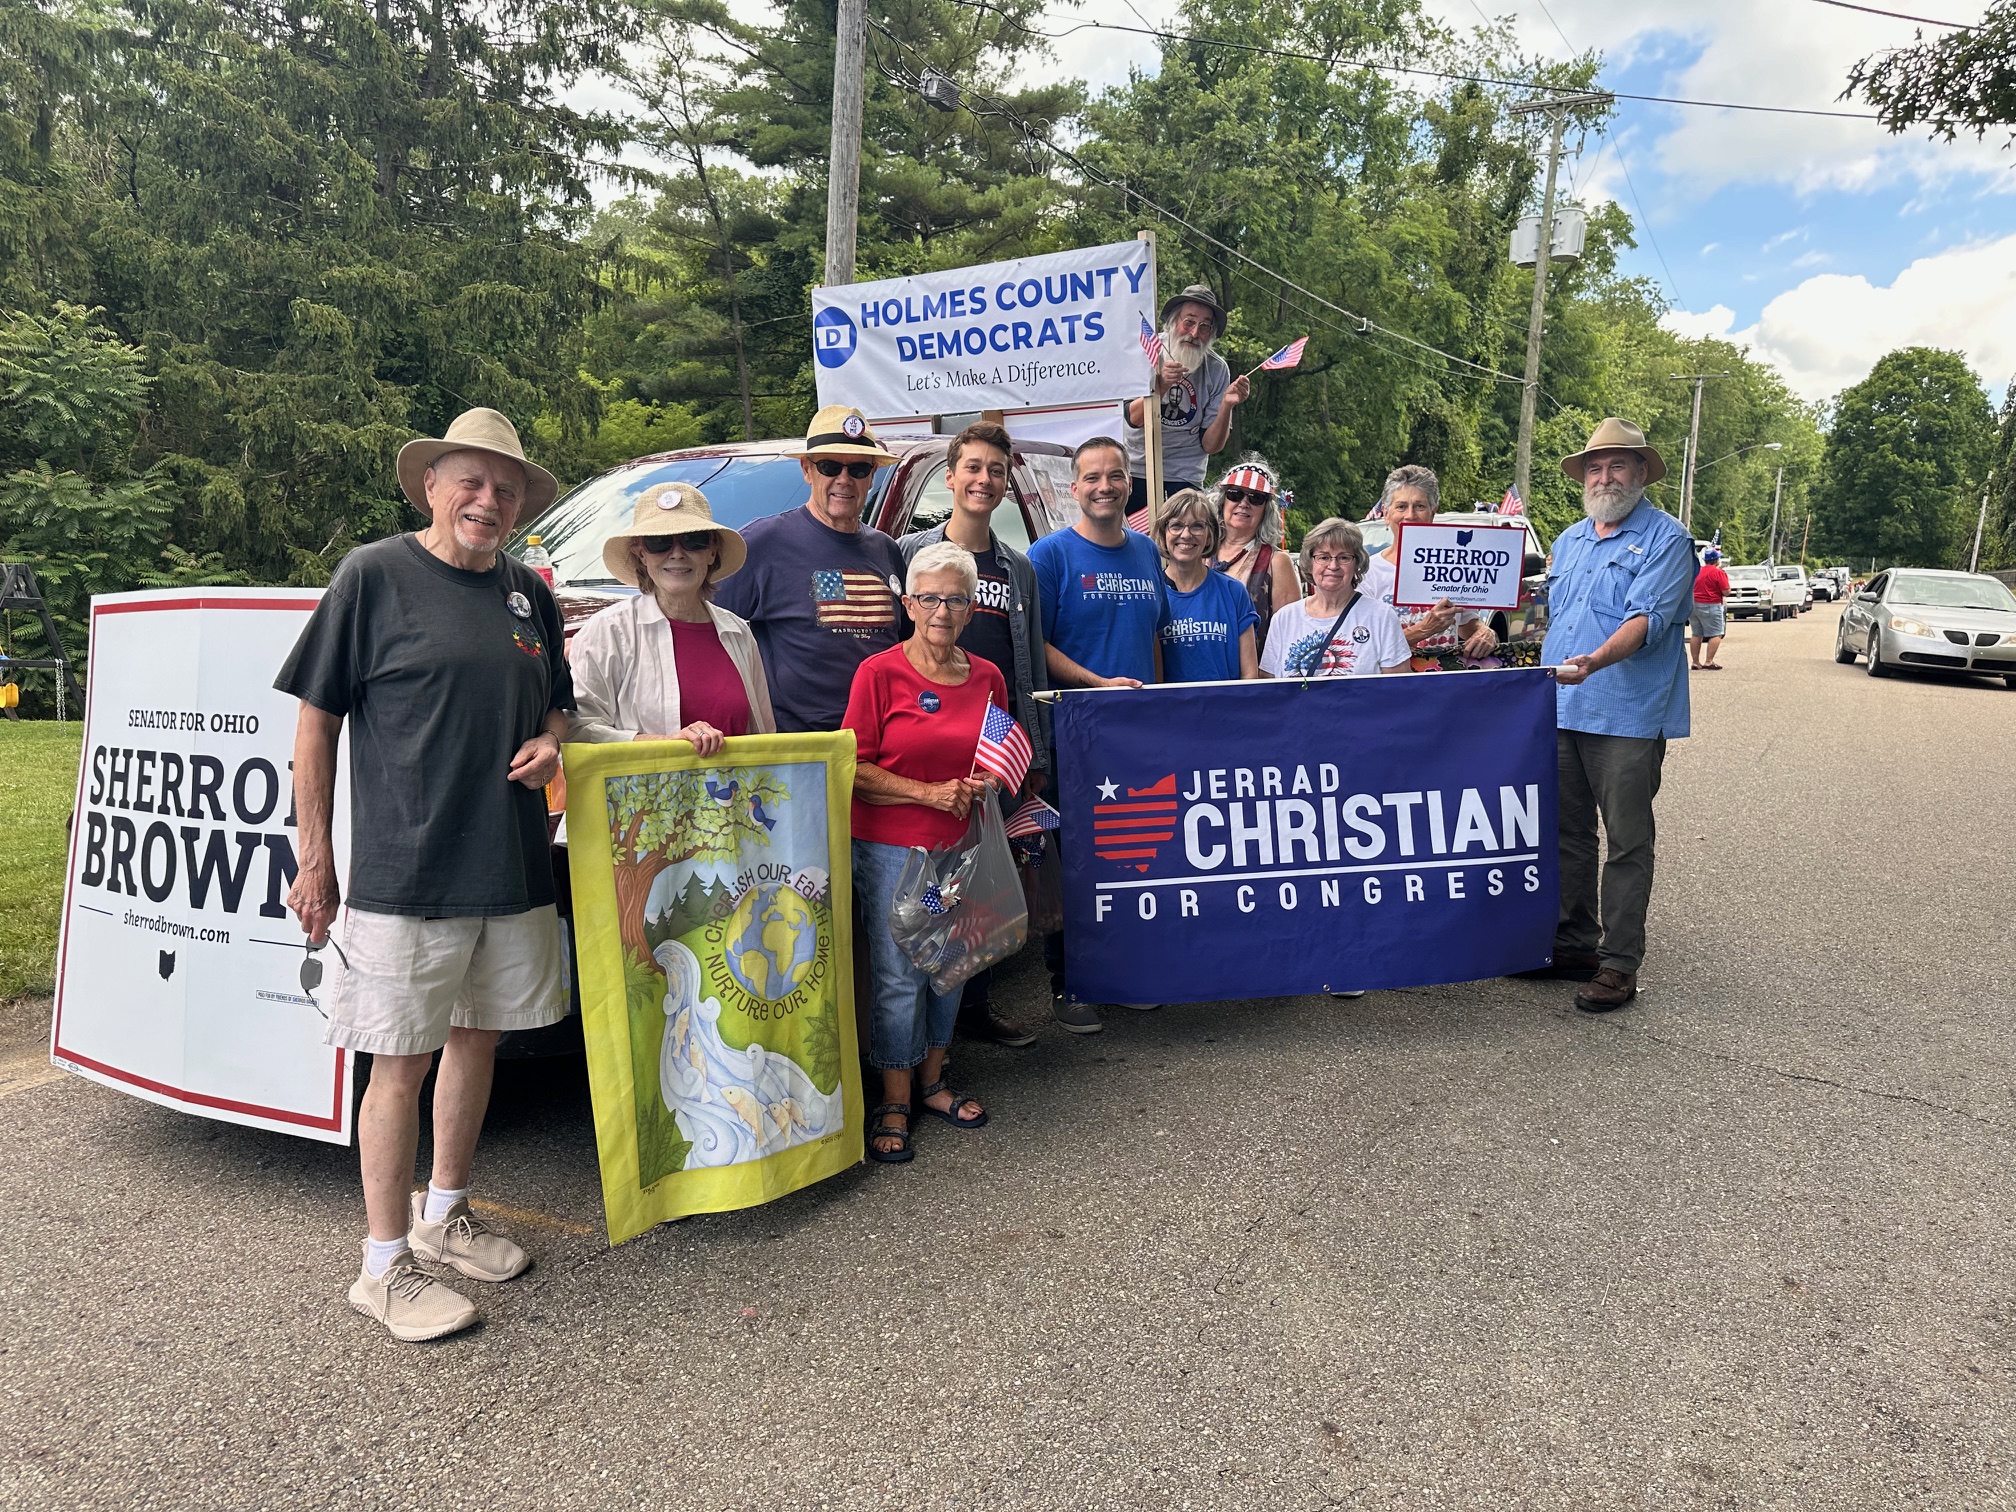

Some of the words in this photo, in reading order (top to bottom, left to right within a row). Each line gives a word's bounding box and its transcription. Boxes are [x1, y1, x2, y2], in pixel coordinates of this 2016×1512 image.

[861, 286, 986, 328] HOLMES
[996, 262, 1147, 311] COUNTY
[825, 328, 841, 347] D
[896, 312, 1105, 362] DEMOCRATS
[946, 369, 987, 389] Make
[992, 366, 1003, 384] A
[1008, 359, 1101, 387] Difference.
[1413, 547, 1510, 567] SHERROD
[1097, 579, 1155, 592] CHRISTIAN
[1422, 565, 1499, 584] BROWN
[1431, 584, 1460, 594] Senator
[1460, 584, 1471, 594] for
[1472, 585, 1489, 594] Ohio
[1163, 621, 1227, 636] CHRISTIAN
[129, 709, 177, 730] SENATOR
[180, 712, 205, 732] FOR
[210, 714, 259, 735] OHIO
[1182, 763, 1340, 801] JERRAD
[1183, 784, 1539, 870] CHRISTIAN
[757, 863, 792, 884] OUR
[1095, 889, 1199, 922] FOR
[1236, 865, 1540, 913] CONGRESS
[124, 909, 231, 944] sherrodbrown.com
[773, 989, 808, 1019] OUR
